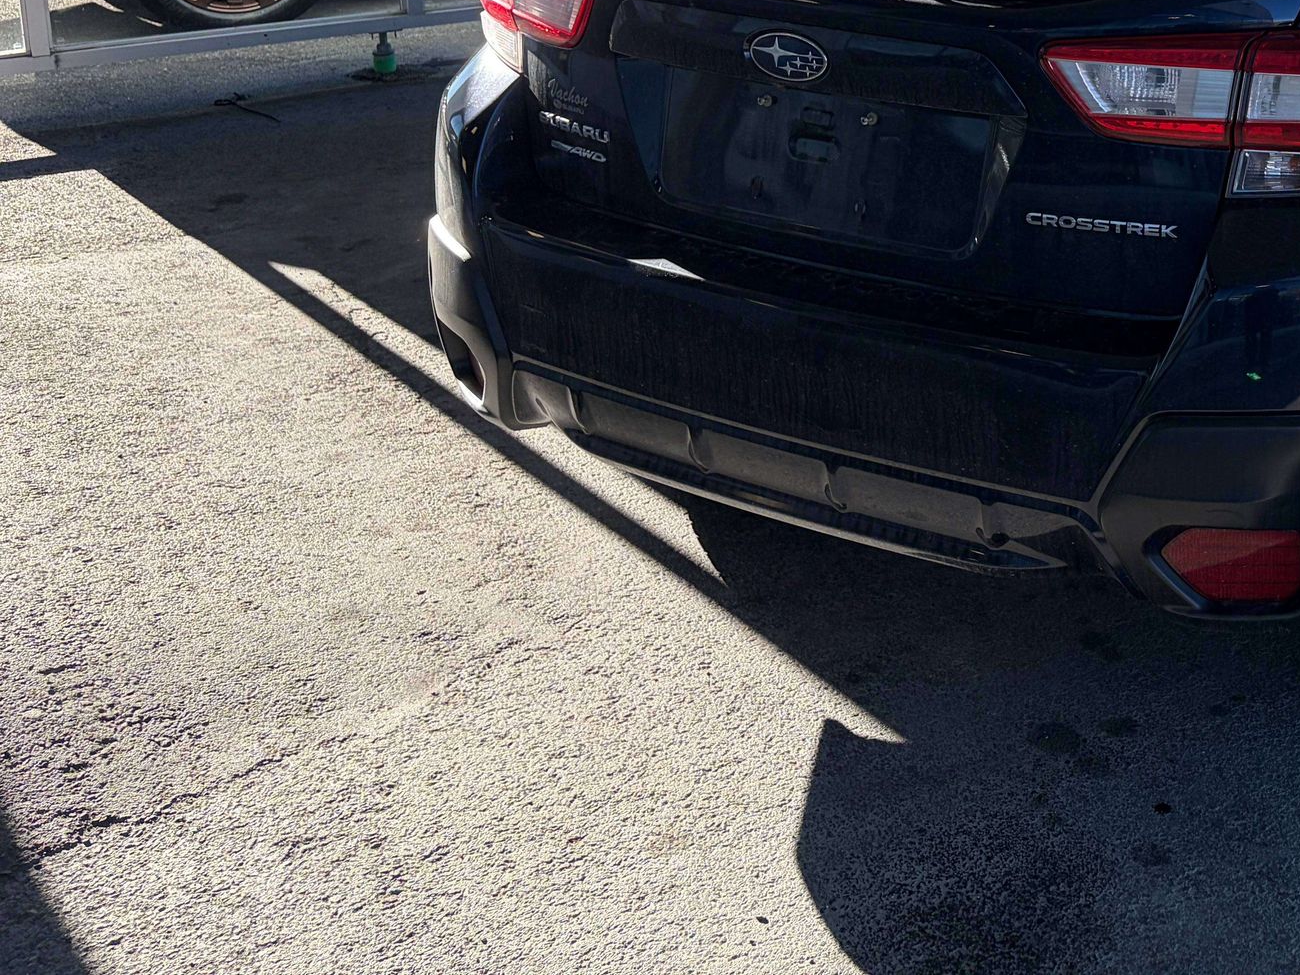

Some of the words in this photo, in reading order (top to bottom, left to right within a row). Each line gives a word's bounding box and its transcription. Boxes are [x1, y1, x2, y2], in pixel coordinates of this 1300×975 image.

[547, 78, 588, 107] Vachon
[569, 146, 607, 163] AWD
[1025, 212, 1178, 239] CROSSTREK
